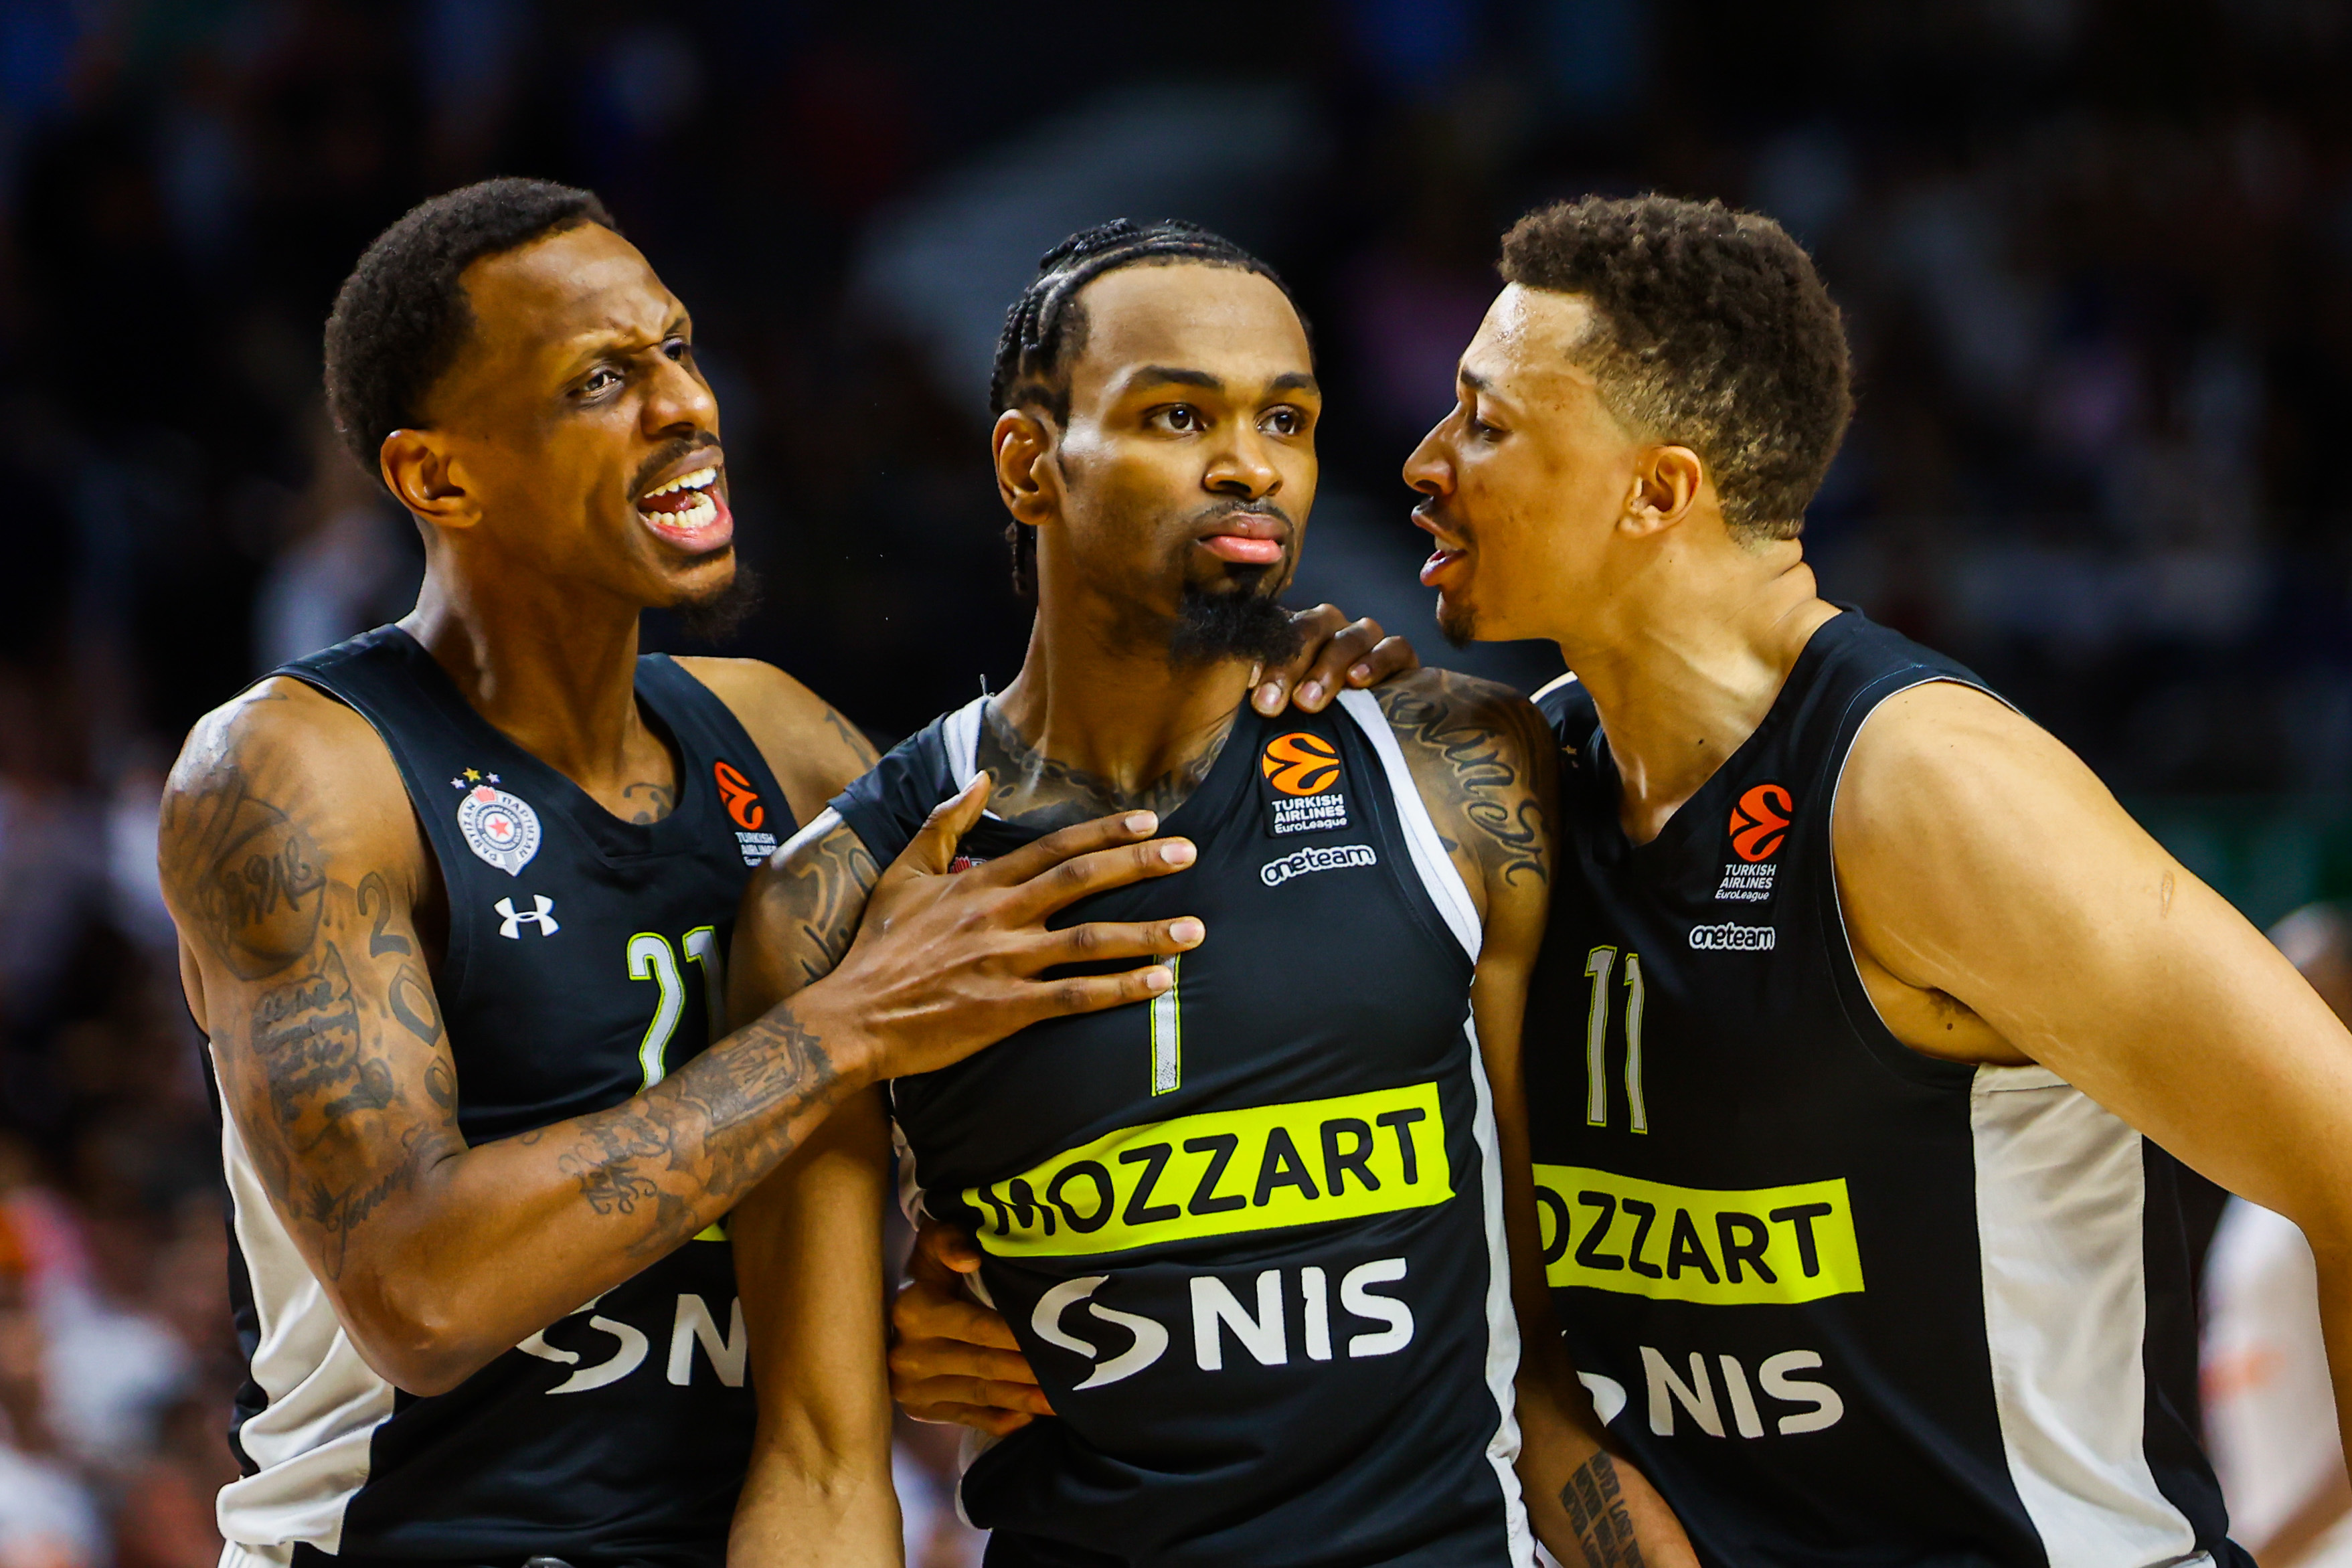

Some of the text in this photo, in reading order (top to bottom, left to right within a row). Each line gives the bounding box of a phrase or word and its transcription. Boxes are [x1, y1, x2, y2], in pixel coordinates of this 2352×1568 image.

[1272, 794, 1344, 812] TURKISH
[1274, 805, 1346, 824] AIRLINES
[1274, 817, 1347, 834] EuroLeague
[734, 832, 776, 845] TURKISH
[1260, 844, 1377, 886] oneteam
[1725, 864, 1777, 877] TURKISH
[1719, 877, 1774, 889] AIRLINES
[1714, 889, 1770, 902] EuroLeague
[1689, 922, 1776, 950] oneteam
[1584, 946, 1648, 1135] 11
[975, 1107, 1426, 1237] MOZZART
[1533, 1184, 1833, 1284] OZZART
[1189, 1257, 1414, 1371] NIS
[1639, 1345, 1845, 1439] NIS
